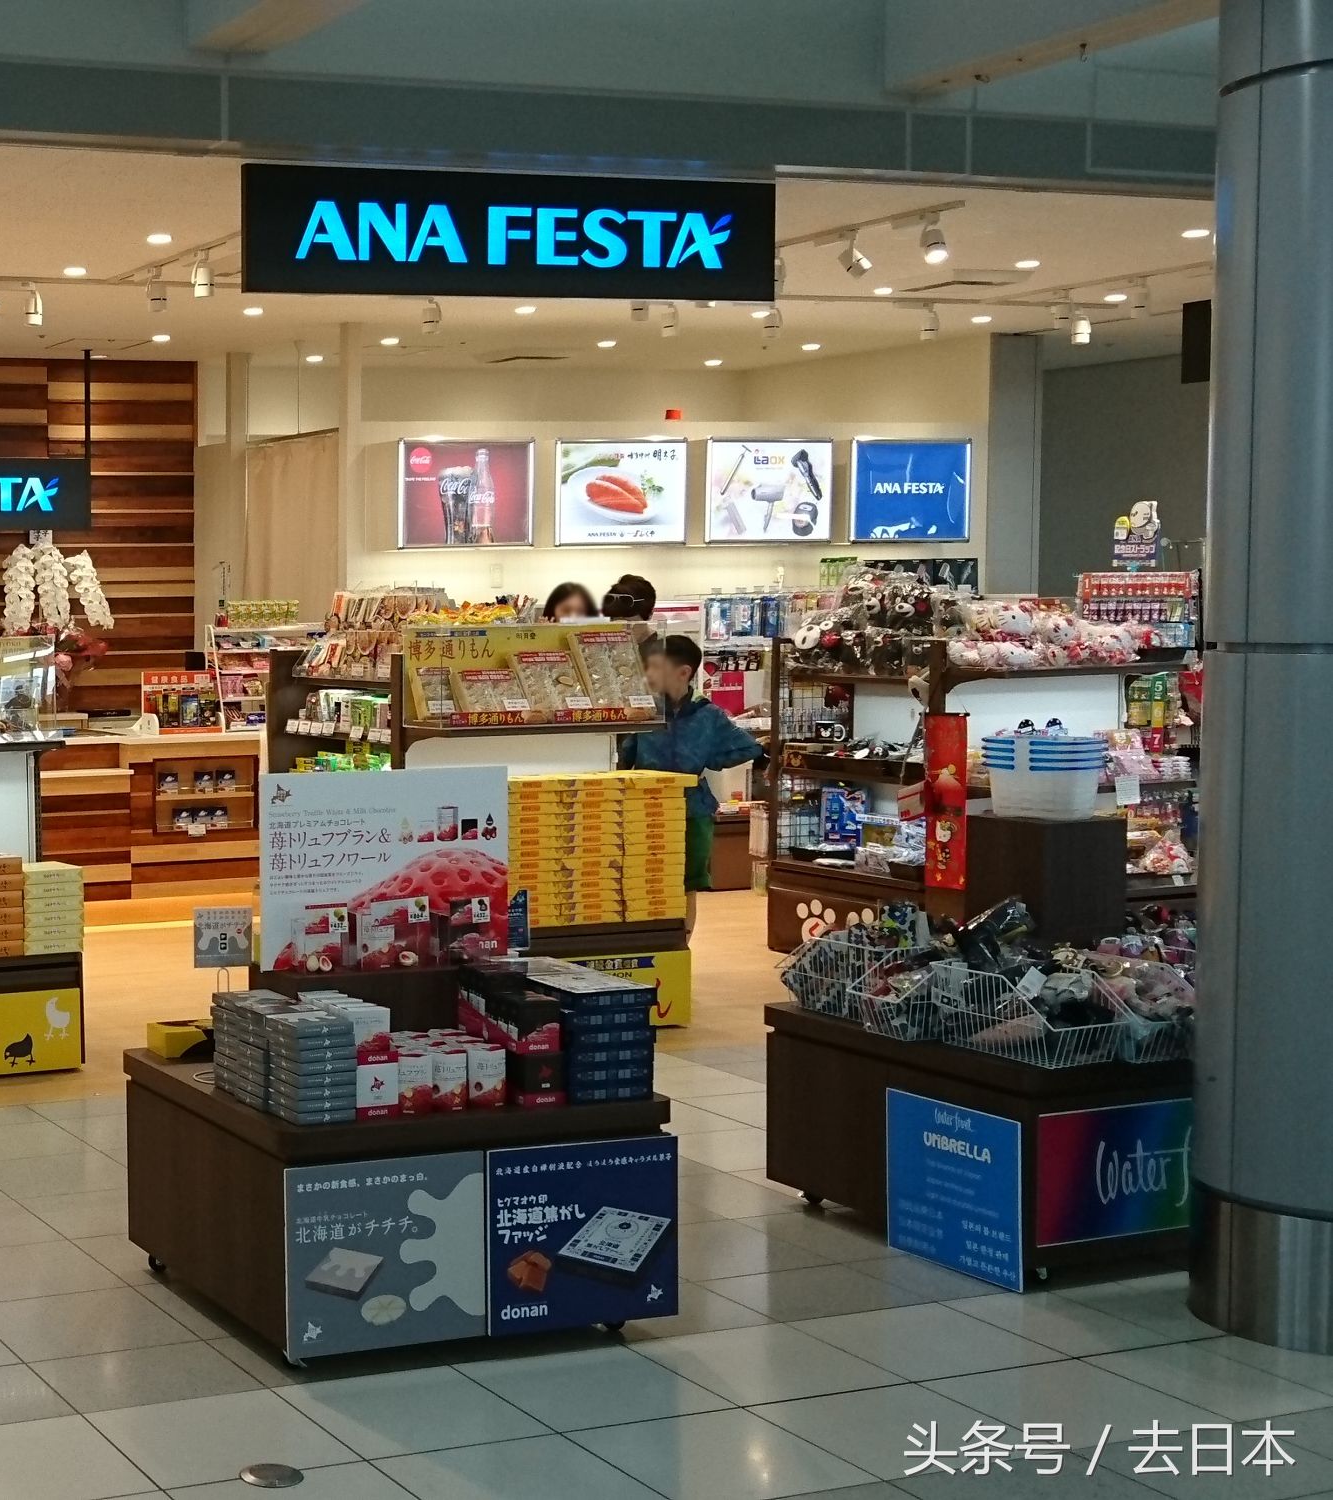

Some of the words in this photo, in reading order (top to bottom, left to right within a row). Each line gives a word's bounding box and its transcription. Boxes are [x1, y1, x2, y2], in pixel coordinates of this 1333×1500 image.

[295, 200, 468, 263] ANA
[488, 206, 732, 270] FESTA
[873, 482, 902, 494] ANA
[903, 482, 945, 494] FESTA
[408, 638, 496, 661] 博多通りもん
[1154, 681, 1163, 692] 5
[572, 709, 627, 722] 博多通りもん
[1154, 706, 1162, 717] 6
[468, 712, 525, 726] 博多通りもん
[1152, 734, 1161, 744] 7
[269, 810, 301, 818] Strawberry
[353, 807, 367, 815] Milk
[268, 818, 366, 831] 北海道プレミアムチョコレート
[269, 828, 392, 850] 苺トリュフブラン&
[269, 852, 392, 872] 苺トリュフノワール
[529, 1043, 550, 1051] donan
[367, 1053, 388, 1062] donan
[536, 1095, 556, 1104] donan
[367, 1107, 388, 1116] donan
[923, 1131, 992, 1164] UMBRELLA
[1095, 1138, 1172, 1205] Water
[497, 1193, 548, 1208] ヒグマオウ印
[295, 1211, 368, 1224] 北海道牛乳チョコレート
[496, 1203, 586, 1228] 北海道焦がし
[295, 1216, 418, 1244] 北海道がチチチ。
[498, 1225, 549, 1245] ファッジ
[501, 1304, 548, 1320] donan
